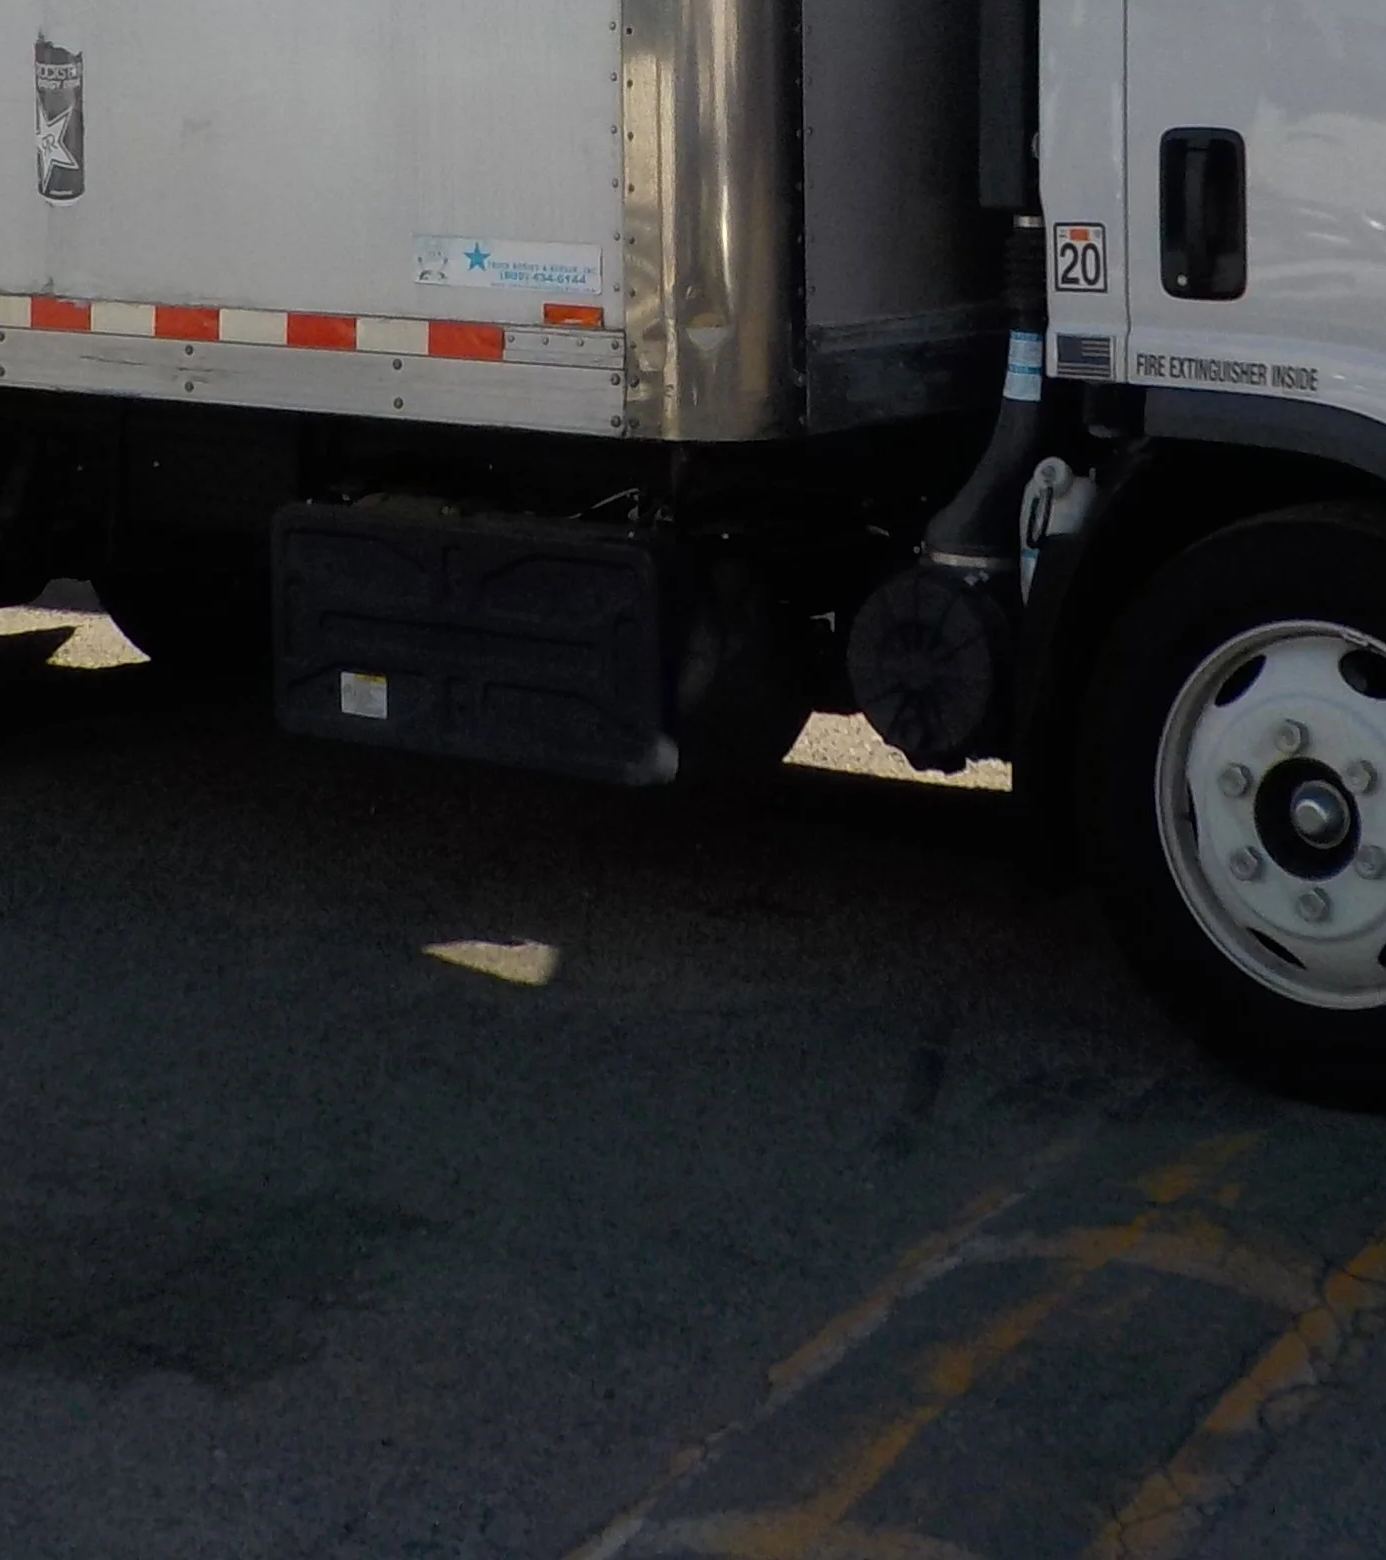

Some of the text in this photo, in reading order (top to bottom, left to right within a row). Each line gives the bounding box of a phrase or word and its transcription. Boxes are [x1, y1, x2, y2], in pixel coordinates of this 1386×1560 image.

[1060, 242, 1101, 286] 20
[1136, 352, 1318, 391] FIRE EXTINGUISHER INSIDE
